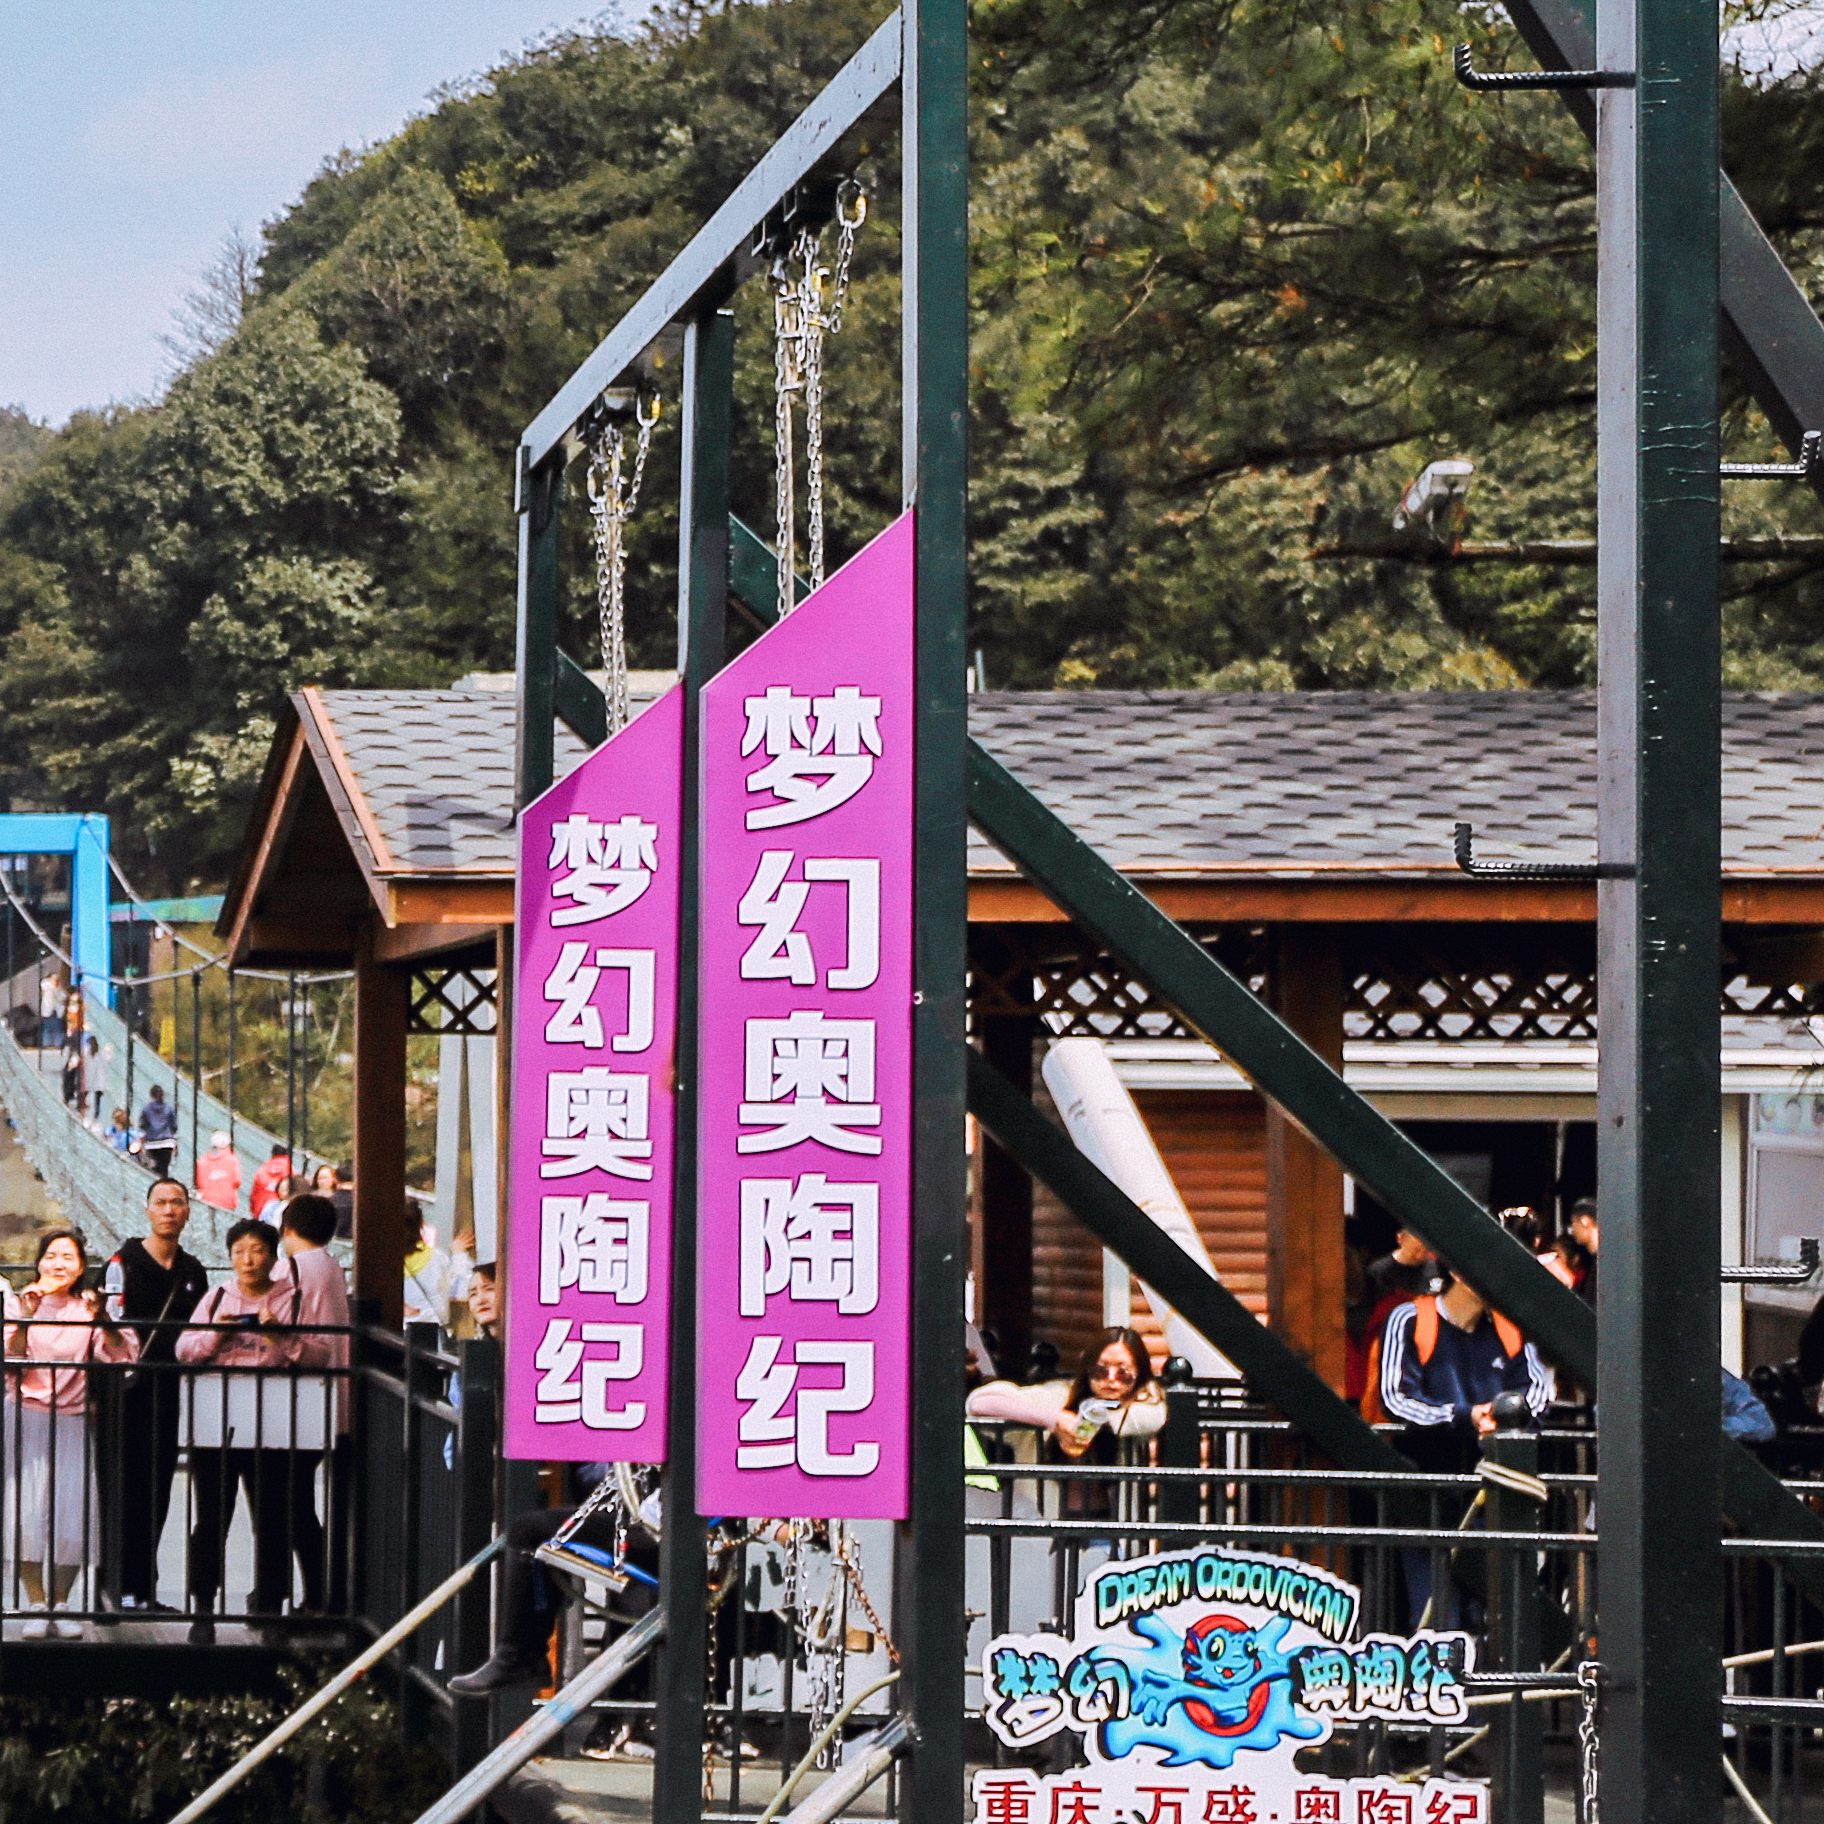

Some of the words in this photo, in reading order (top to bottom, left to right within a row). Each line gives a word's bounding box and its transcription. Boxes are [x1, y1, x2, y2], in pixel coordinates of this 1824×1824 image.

[534, 813, 659, 1431] 梦幻奥陶纪
[734, 683, 882, 1477] 梦幻奥陶纪
[991, 1648, 1130, 1740] 梦幻
[1295, 1638, 1466, 1717] 奥陶纪
[1096, 1559, 1191, 1629] DREAM
[1195, 1553, 1356, 1642] ORDOVICIAN
